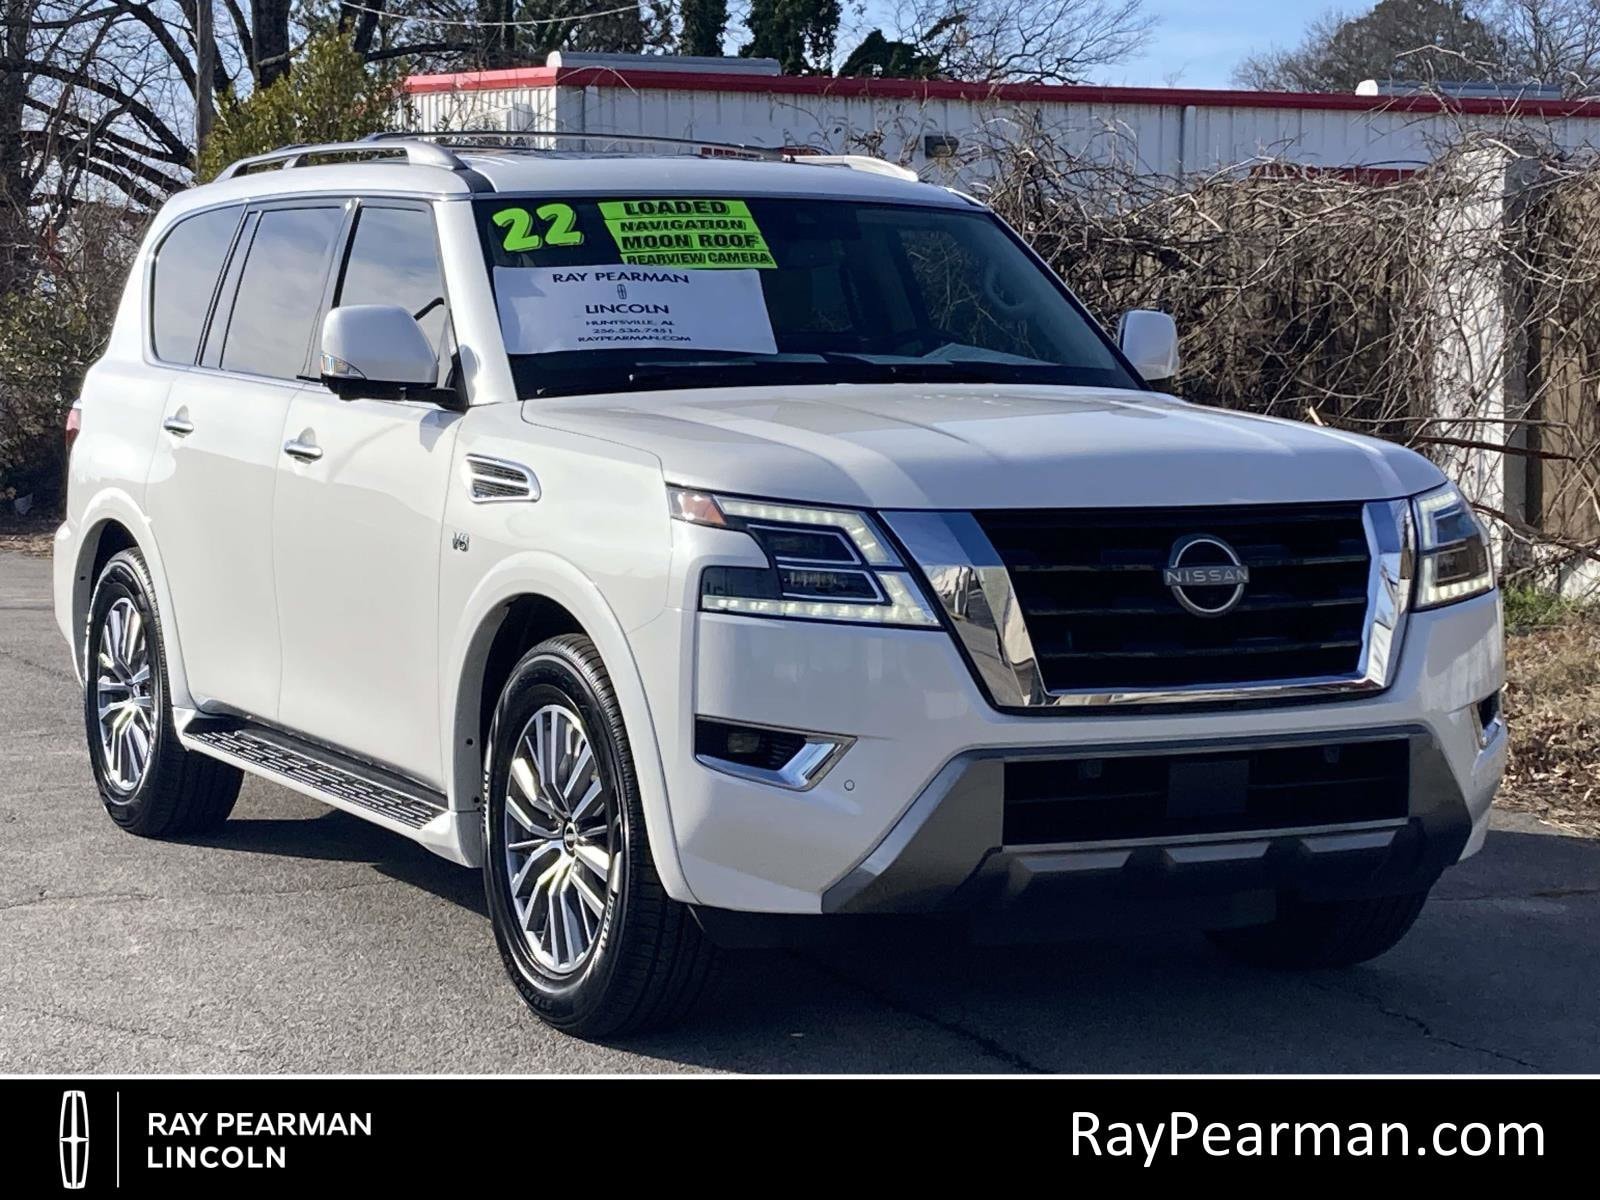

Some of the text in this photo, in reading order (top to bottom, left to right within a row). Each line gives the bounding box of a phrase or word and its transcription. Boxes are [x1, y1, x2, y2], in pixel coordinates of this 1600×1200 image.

[624, 201, 729, 216] LOADED
[492, 203, 585, 252] 22
[620, 220, 747, 233] NAVIGATION
[622, 234, 760, 249] MOON ROOF
[626, 252, 773, 265] REARVIEW CAMERA
[552, 272, 690, 284] RAY PEARMAN
[585, 304, 669, 314] LINCOLN
[1166, 569, 1249, 583] NISSAN
